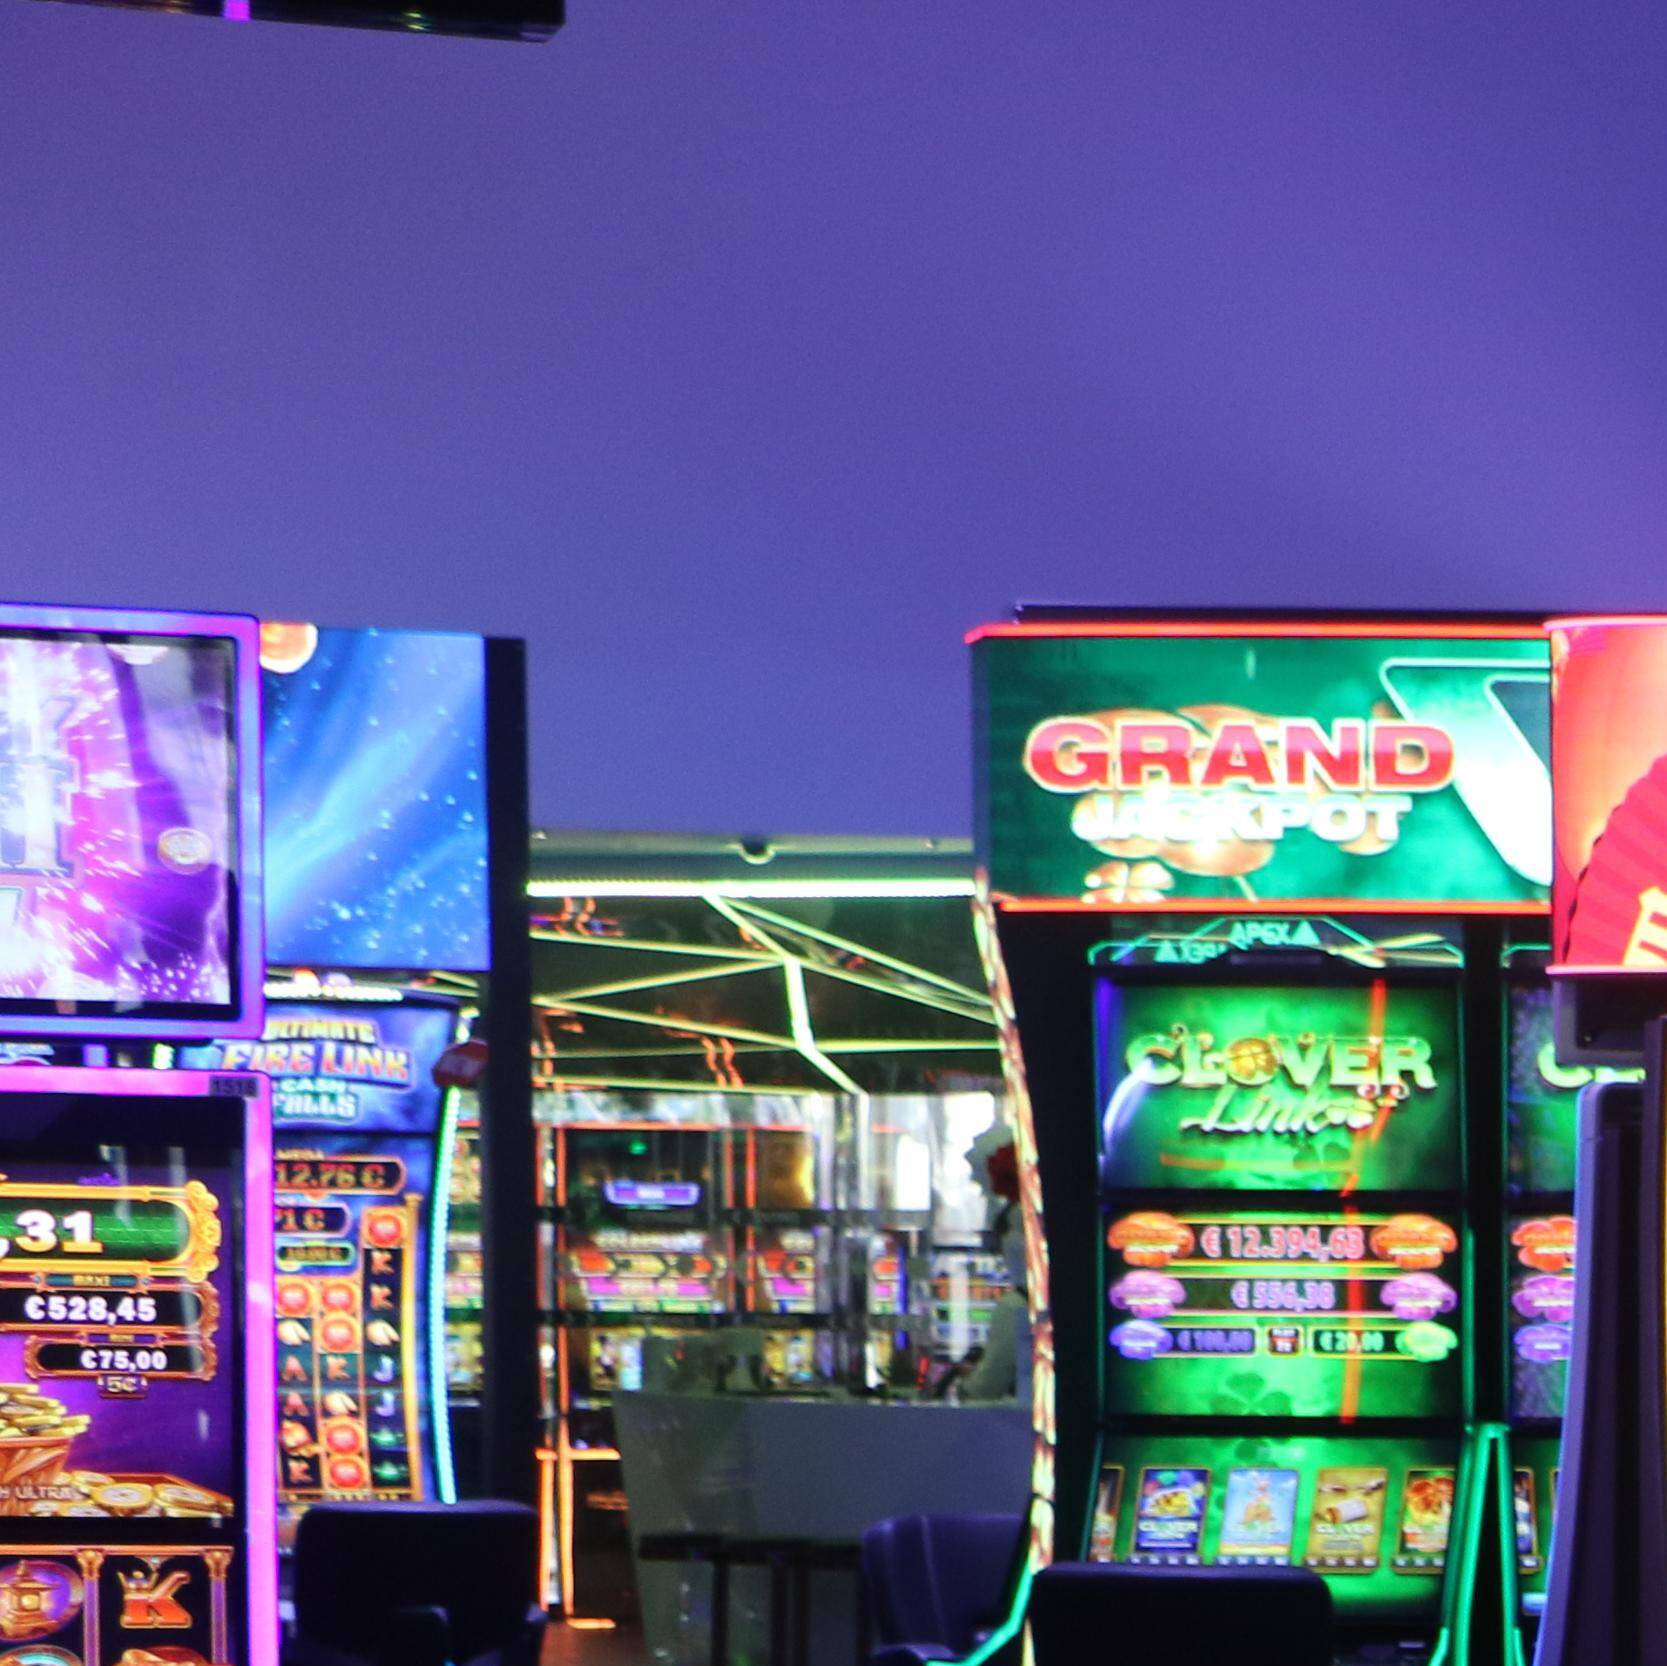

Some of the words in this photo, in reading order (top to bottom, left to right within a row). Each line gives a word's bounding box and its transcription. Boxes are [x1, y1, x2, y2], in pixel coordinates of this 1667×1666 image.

[1026, 718, 1455, 793] GRAND
[1074, 795, 1412, 842] JACKPOT
[1229, 922, 1292, 946] APEX
[322, 1041, 410, 1080] LINK
[1126, 1030, 1438, 1089] CLOVER
[1178, 1084, 1345, 1134] Link
[24, 1295, 157, 1326] €528,45
[80, 1350, 168, 1372] €75,00
[121, 1570, 193, 1629] K
